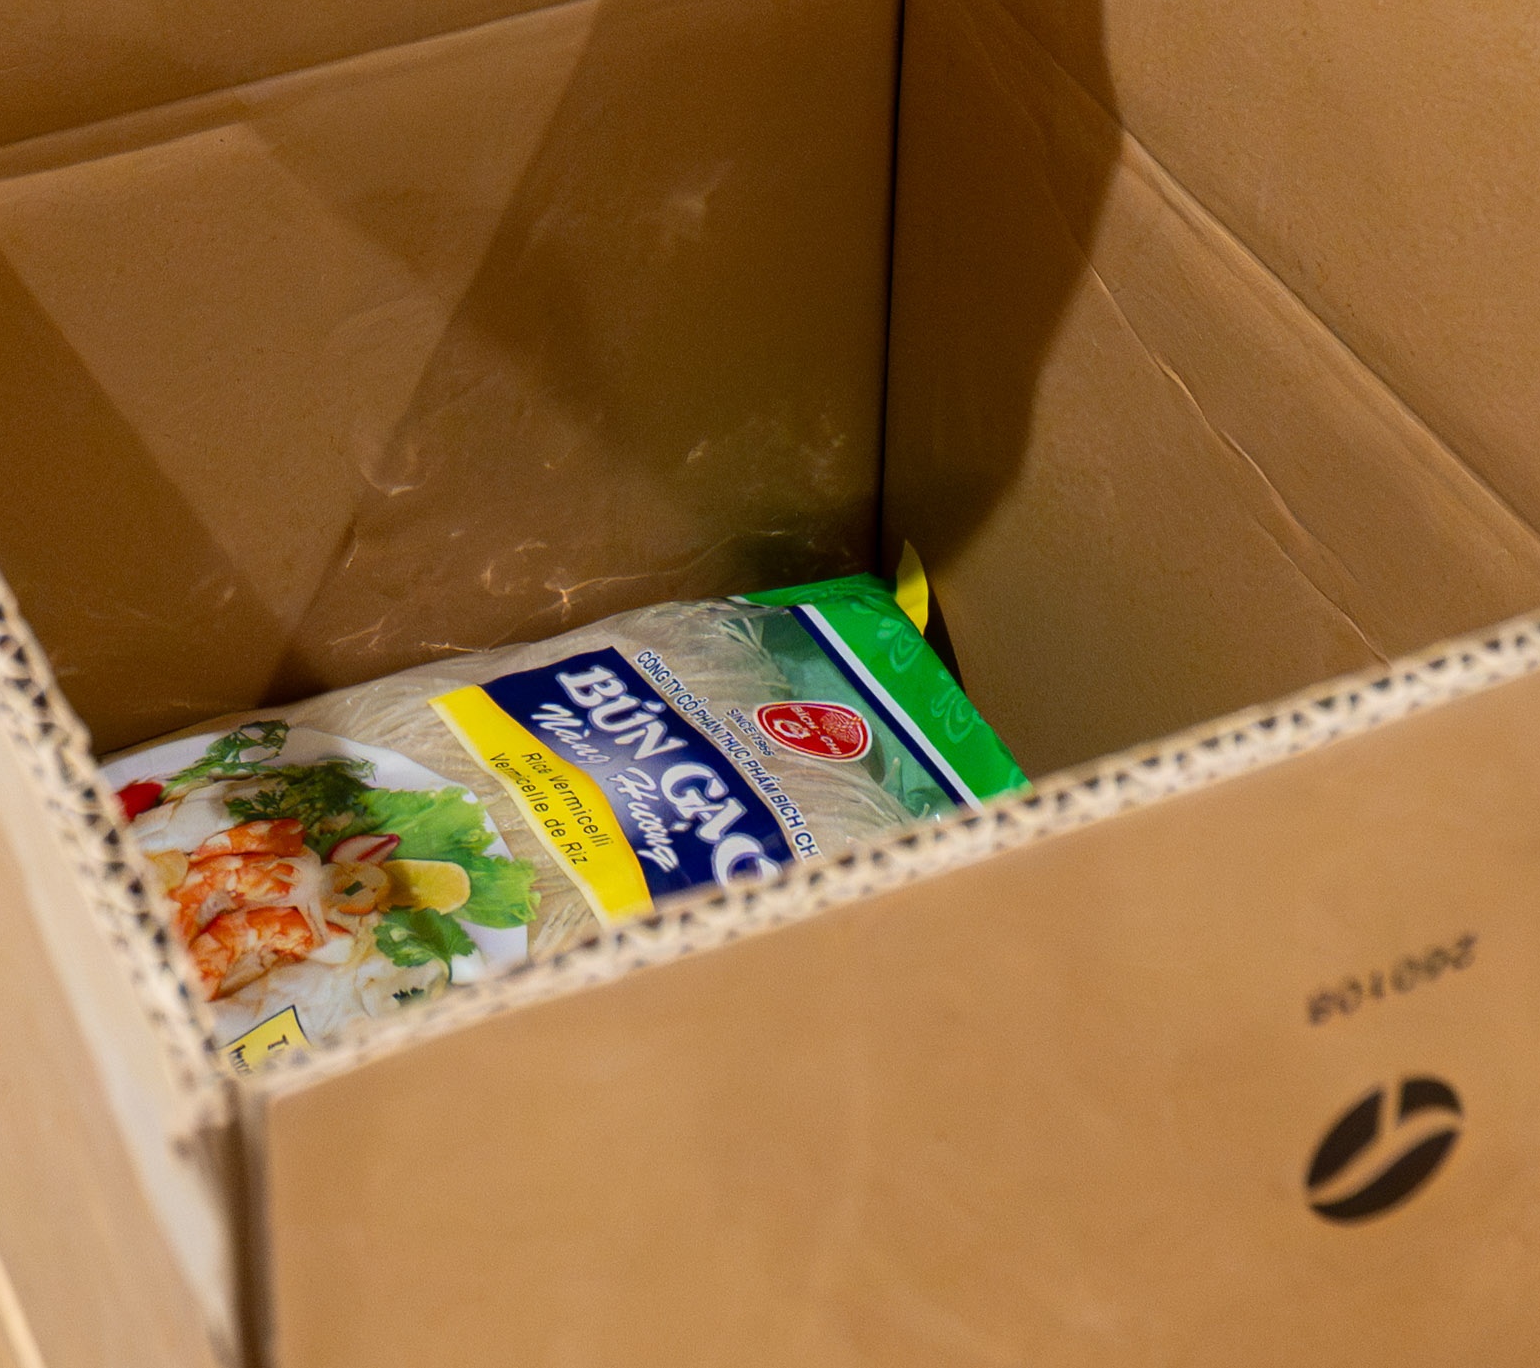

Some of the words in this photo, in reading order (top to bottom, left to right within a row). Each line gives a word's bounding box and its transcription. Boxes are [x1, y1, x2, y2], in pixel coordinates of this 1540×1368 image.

[556, 665, 688, 761] BÚN
[636, 650, 674, 688] CÔNG
[769, 791, 809, 835] BÍCH
[726, 706, 759, 741] SINCE
[790, 704, 819, 735] BÍCH
[488, 751, 548, 817] Vermicelle
[542, 817, 569, 840] de
[560, 834, 592, 867] Riz
[520, 750, 554, 782] Rice
[547, 771, 616, 850] Vermicelli
[530, 702, 612, 766] Nàng
[608, 766, 681, 874] Hương
